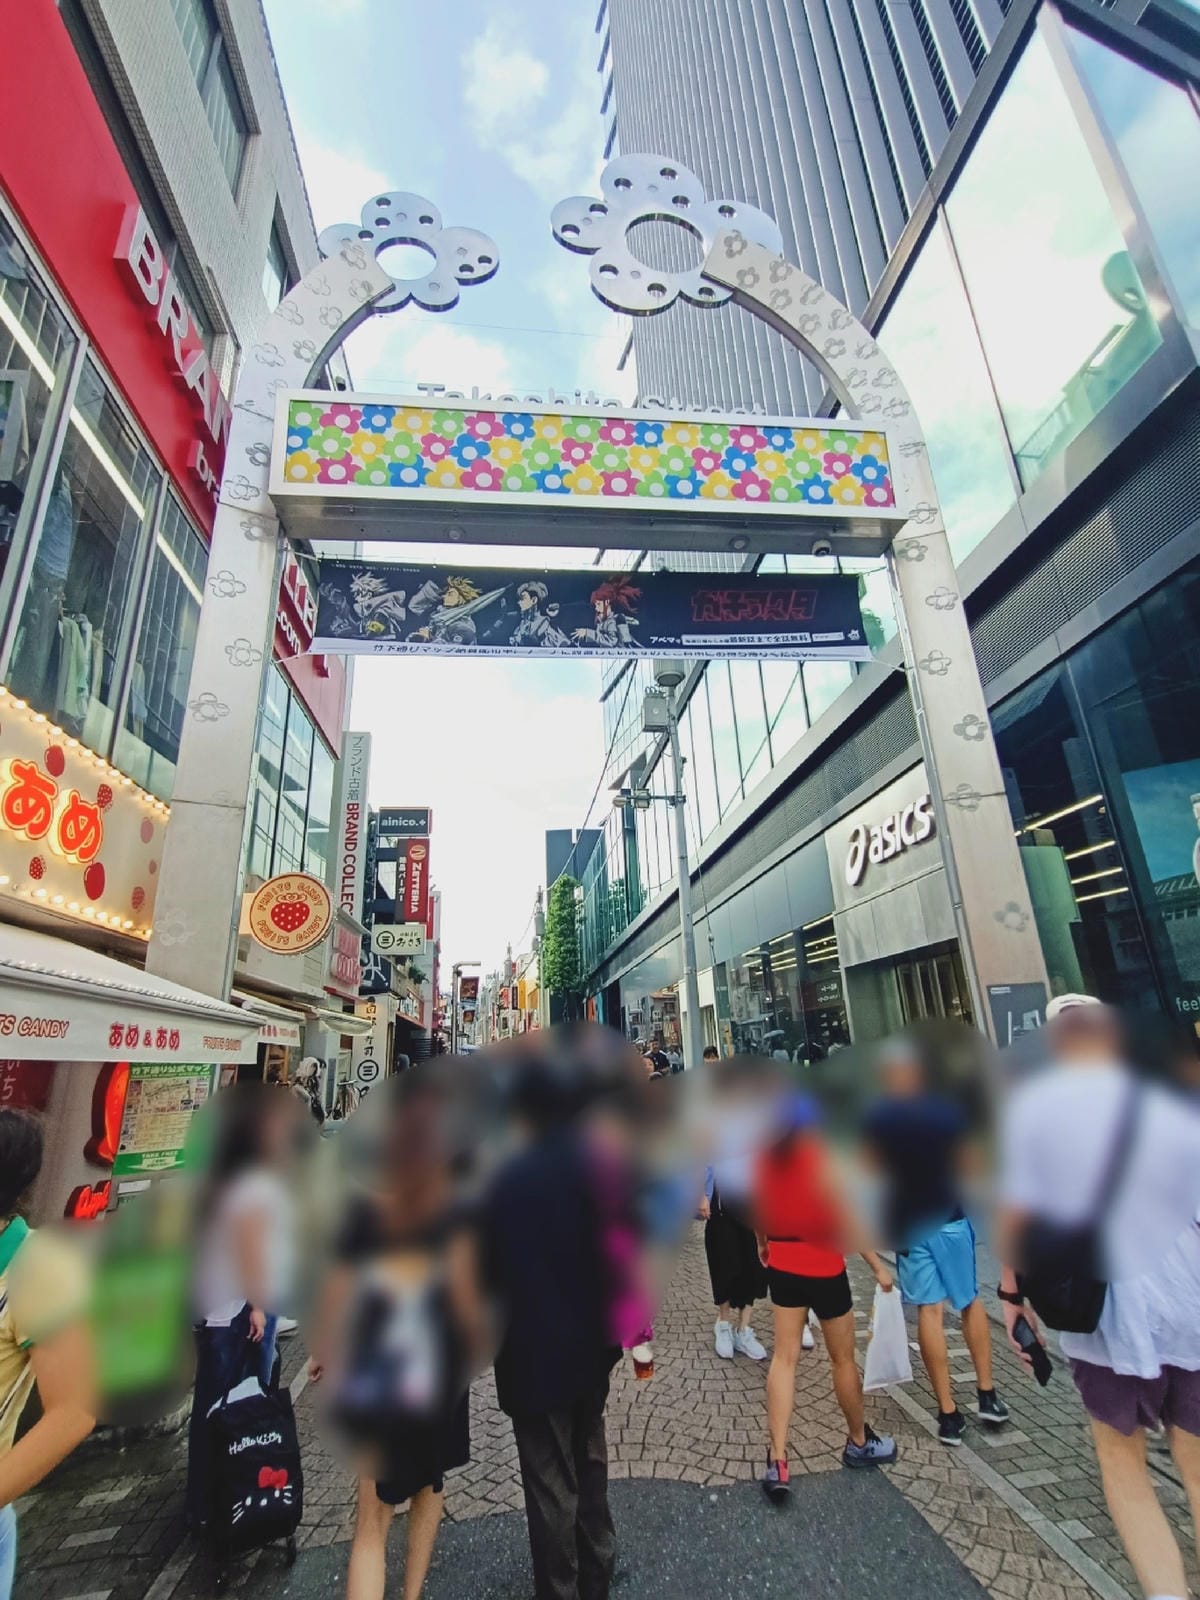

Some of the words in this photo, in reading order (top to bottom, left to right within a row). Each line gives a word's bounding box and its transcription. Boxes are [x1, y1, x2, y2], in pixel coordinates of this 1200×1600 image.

[346, 735, 364, 800] ブランド古着
[2, 757, 104, 864] あめ
[344, 802, 360, 851] BRAND
[869, 794, 935, 865] asics
[257, 881, 292, 911] FRUITS
[297, 882, 324, 906] CANDY
[340, 853, 356, 917] COLLEC
[410, 862, 422, 914] ZETTERIA
[256, 919, 290, 945] FRUITS
[295, 914, 322, 942] CANDY
[18, 1016, 70, 1038] CANDY
[228, 1437, 256, 1456] Hello
[256, 1431, 282, 1447] Kitty
